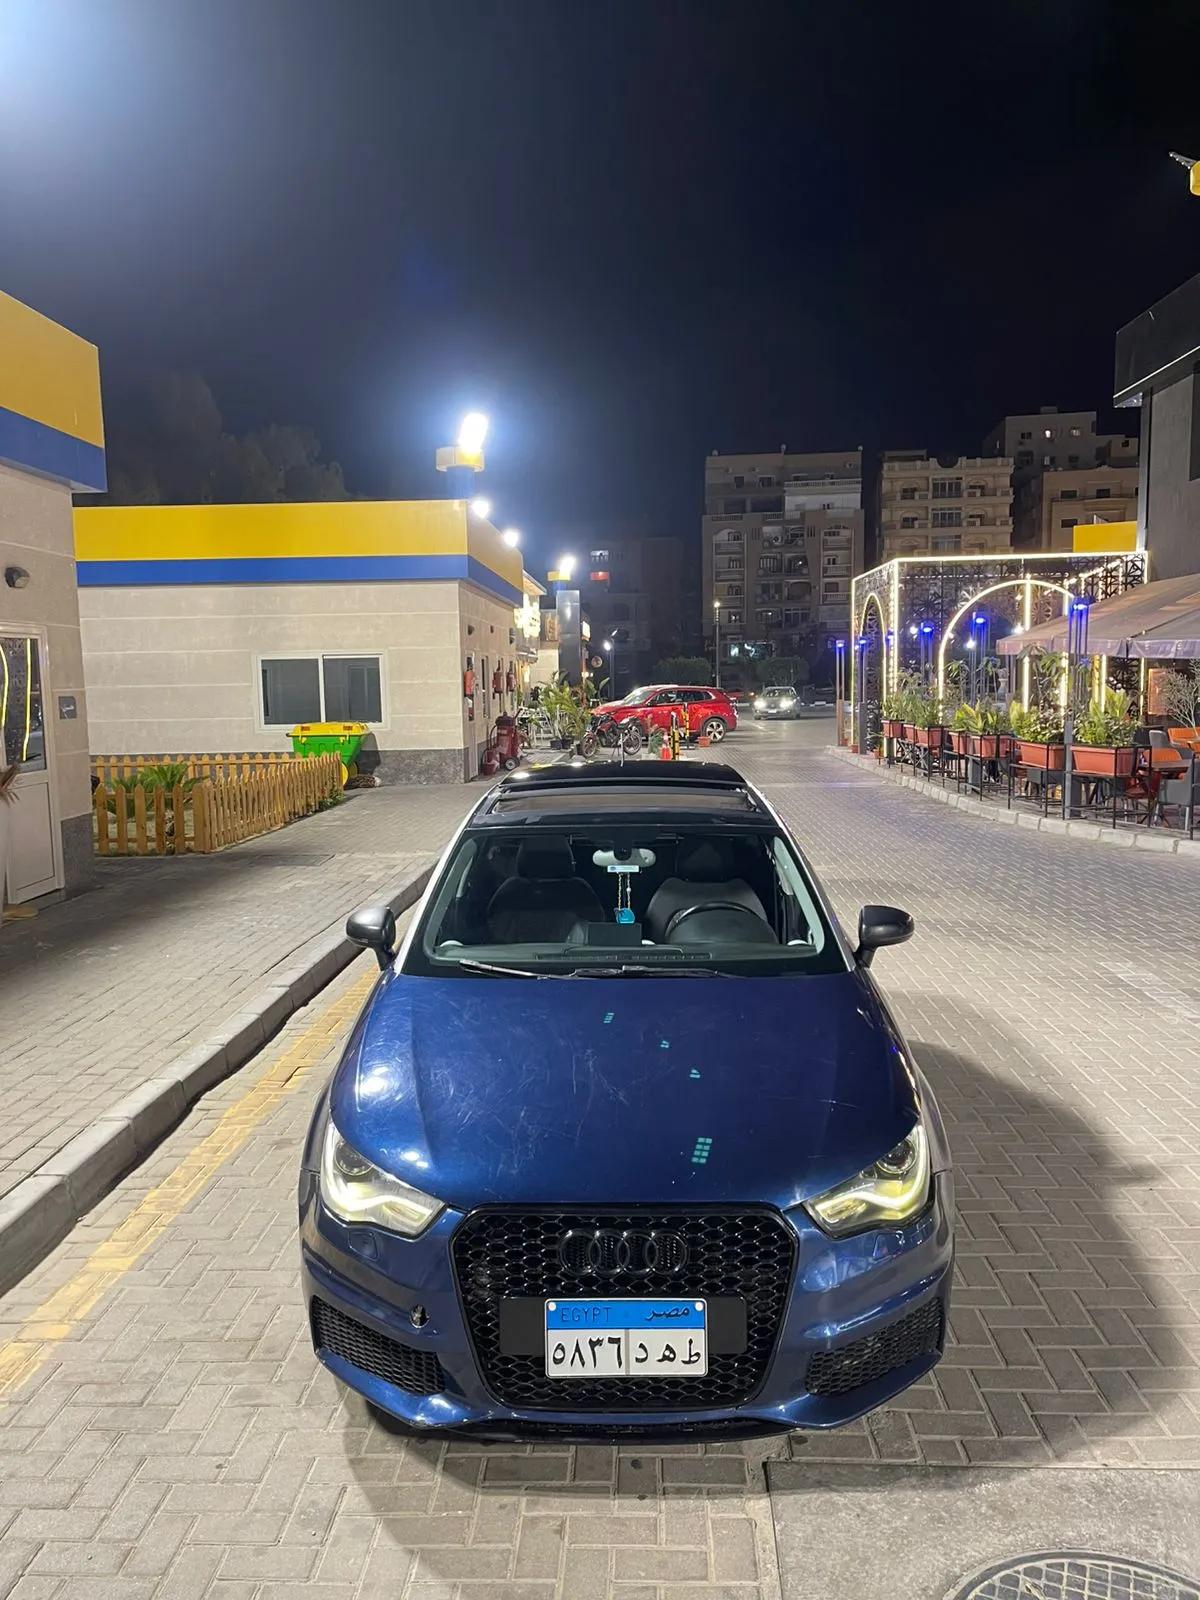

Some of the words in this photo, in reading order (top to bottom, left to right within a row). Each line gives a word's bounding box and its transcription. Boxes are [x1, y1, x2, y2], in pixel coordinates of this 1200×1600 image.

[561, 1306, 612, 1322] EGYPT
[645, 1307, 690, 1321] مصر
[553, 1336, 622, 1368] ٥٨٣٦
